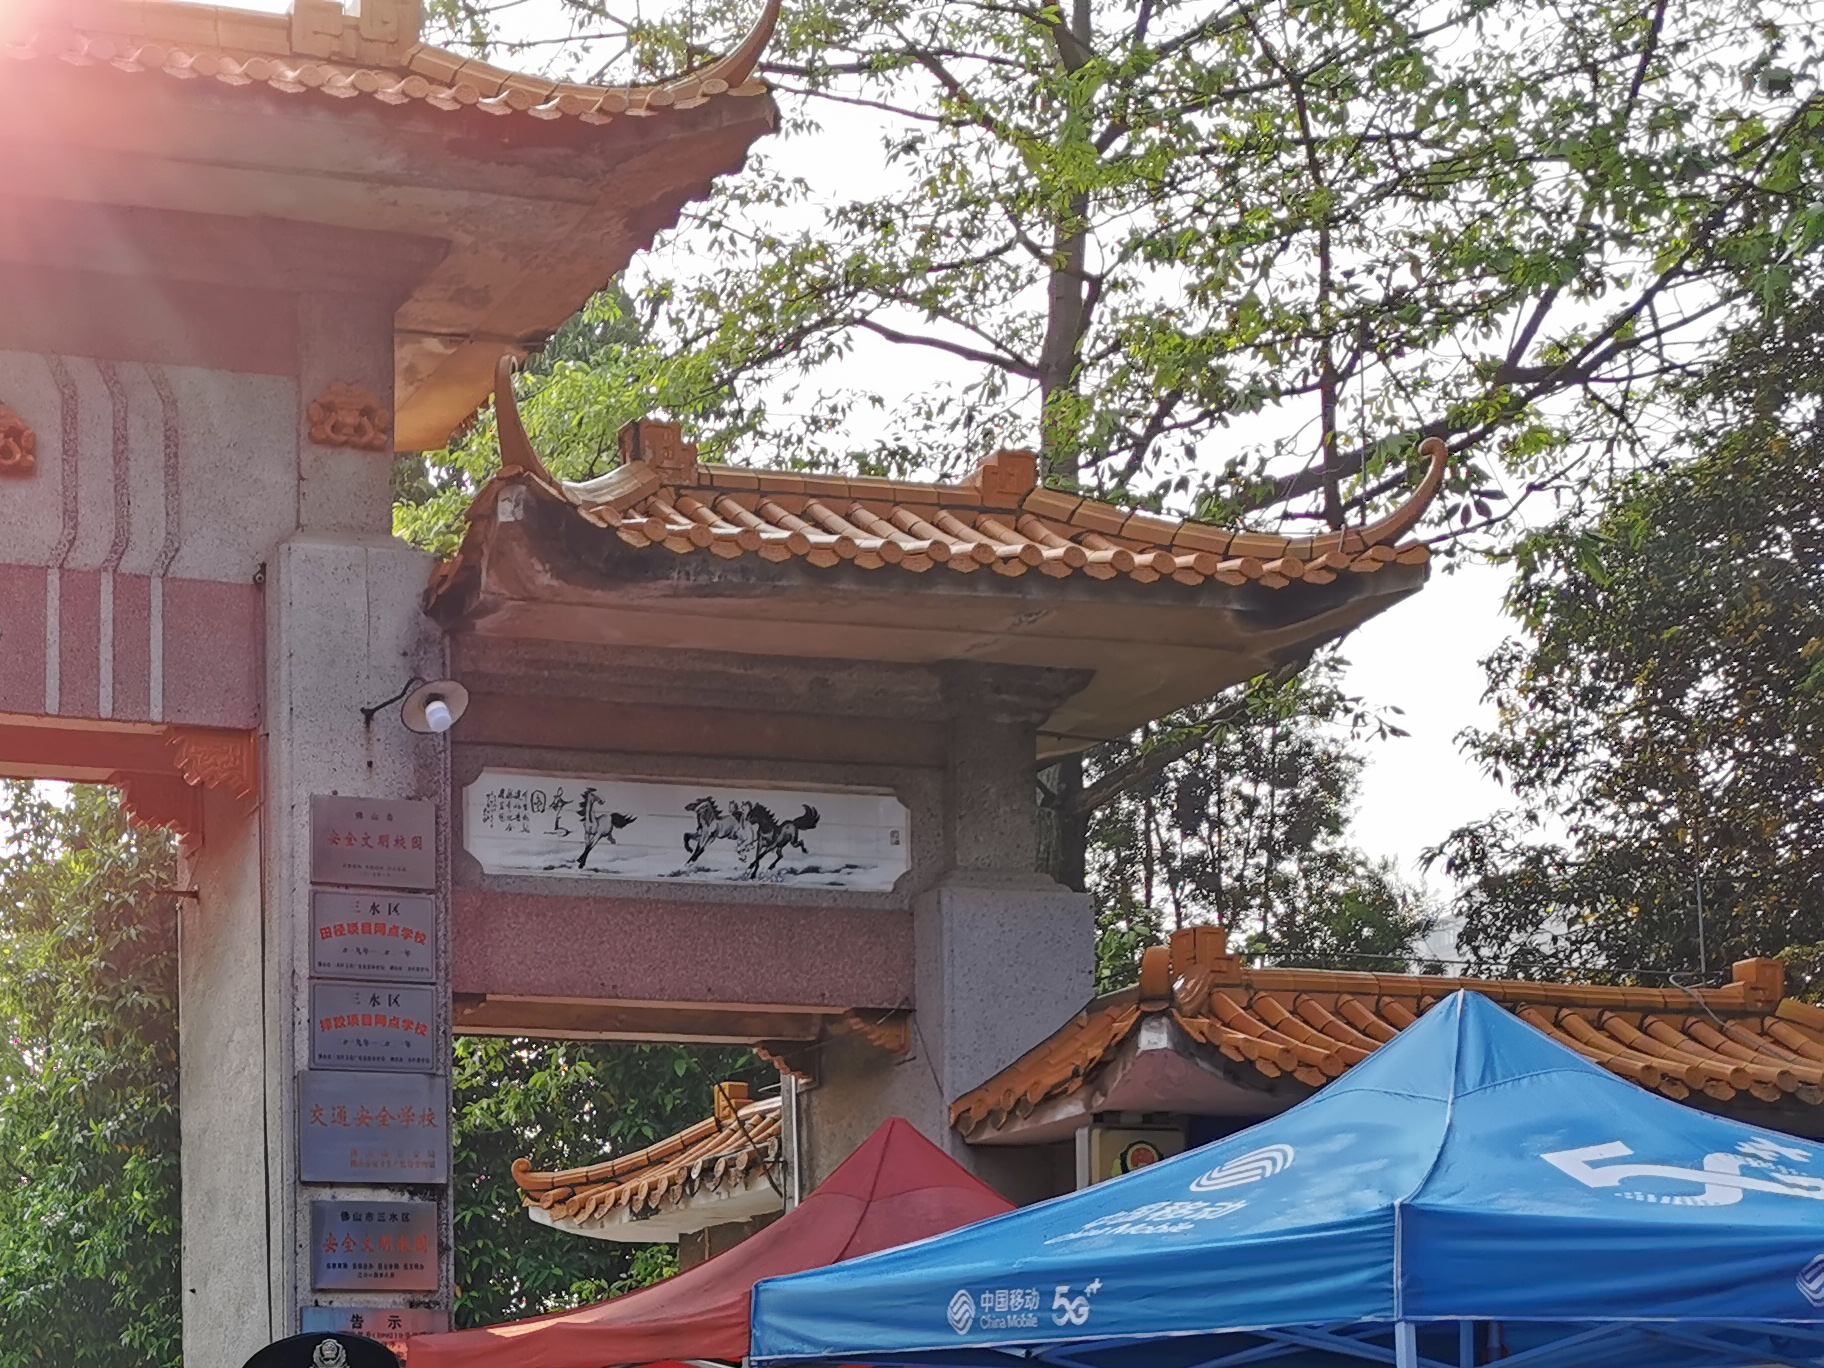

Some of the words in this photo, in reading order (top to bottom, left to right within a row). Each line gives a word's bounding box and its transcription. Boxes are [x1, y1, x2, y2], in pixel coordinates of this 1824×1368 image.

[327, 829, 424, 850] 安全文明校园
[309, 1104, 439, 1129] 交通安全学校
[323, 1232, 429, 1255] 安全文明校园
[980, 1288, 1040, 1312] 中国移动
[349, 1313, 403, 1330] 告示
[980, 1314, 1006, 1329] China
[1007, 1313, 1039, 1328] Mobile
